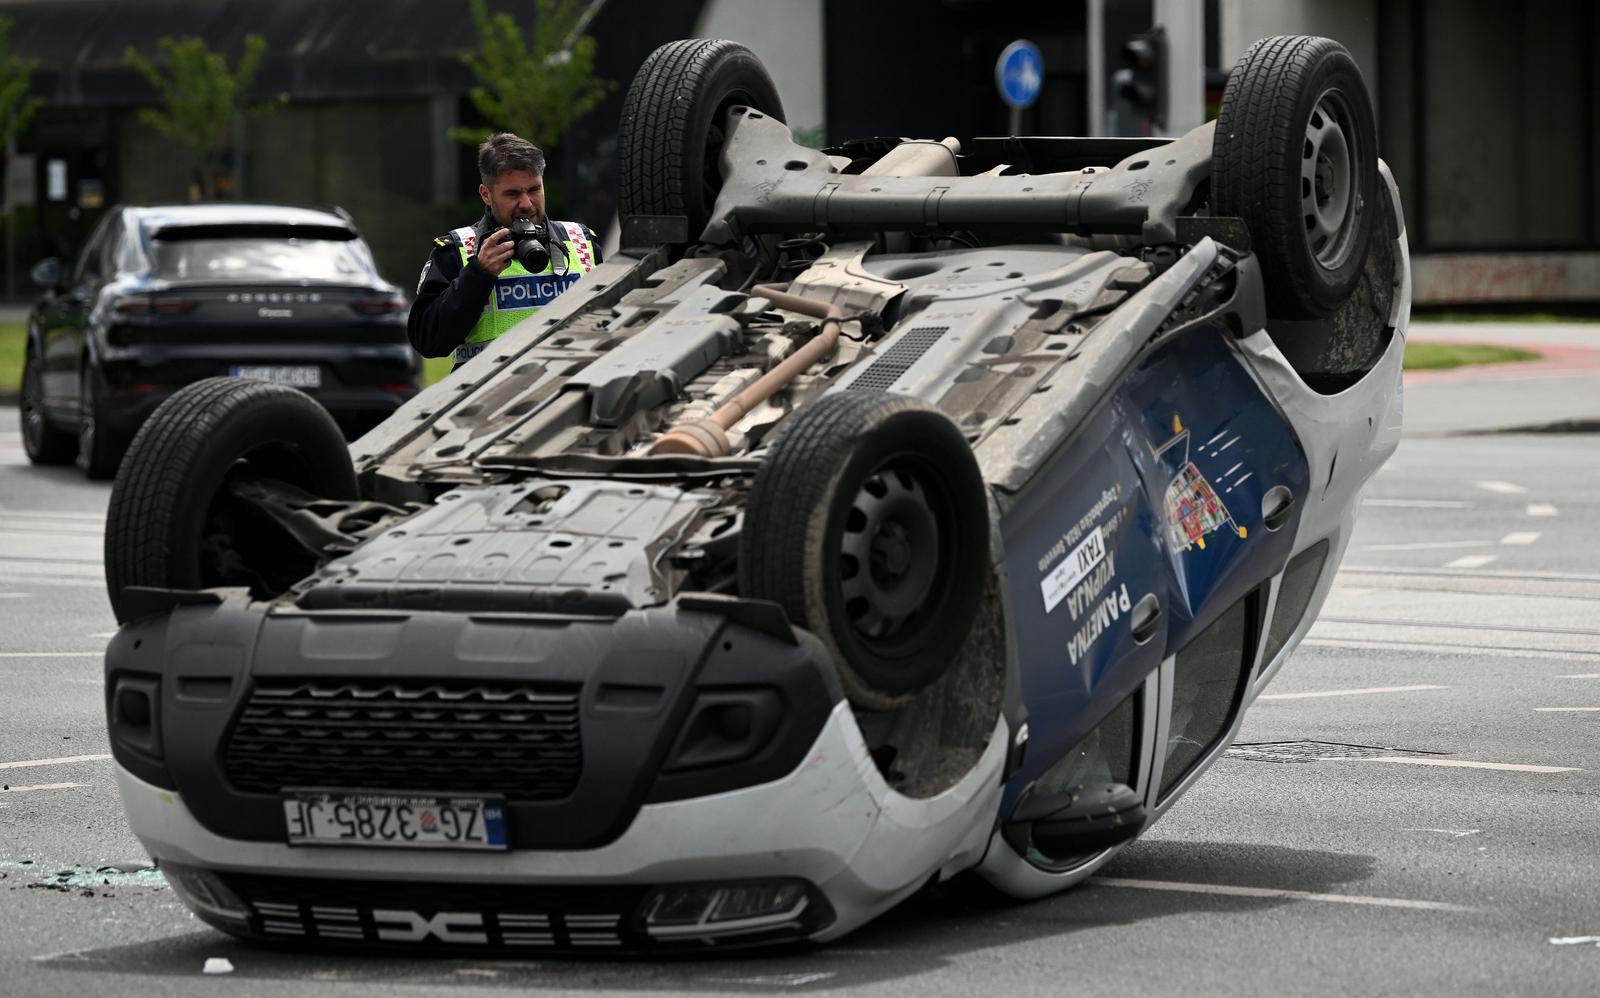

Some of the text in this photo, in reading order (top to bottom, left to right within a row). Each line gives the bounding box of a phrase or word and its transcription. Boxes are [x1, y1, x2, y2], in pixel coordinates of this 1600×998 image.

[1077, 535, 1102, 573] TAXI
[1066, 549, 1115, 621] KUPNJA
[1066, 582, 1131, 666] PAMETNA
[441, 807, 483, 841] ZG
